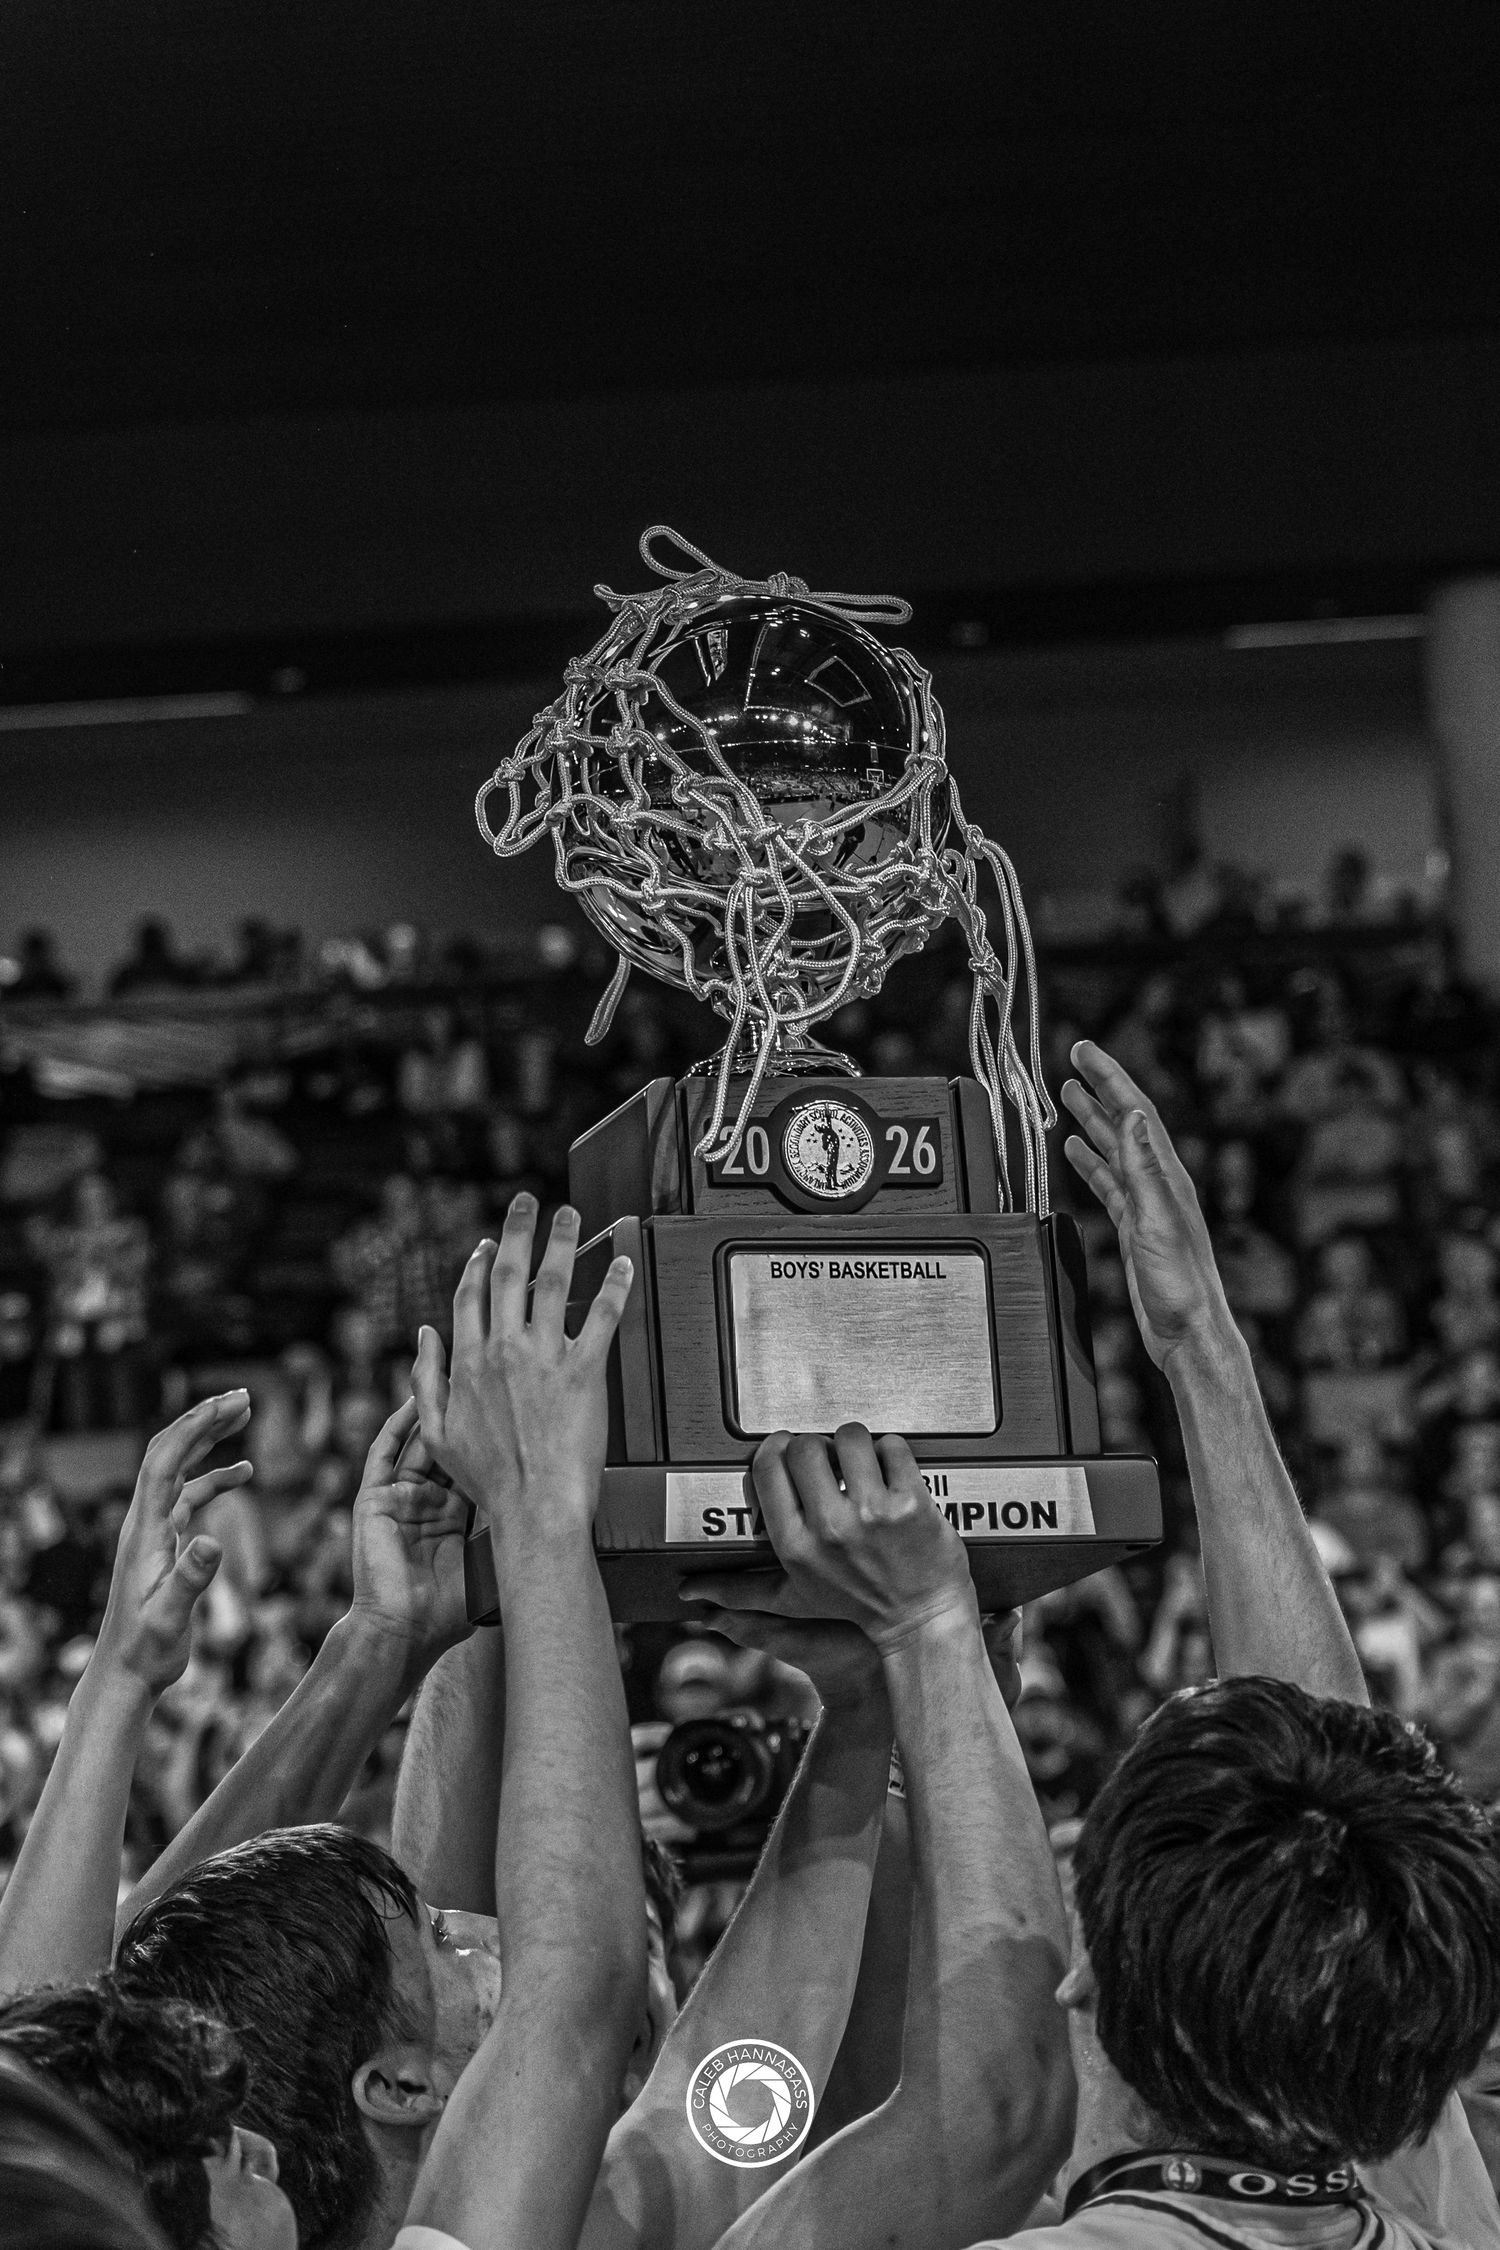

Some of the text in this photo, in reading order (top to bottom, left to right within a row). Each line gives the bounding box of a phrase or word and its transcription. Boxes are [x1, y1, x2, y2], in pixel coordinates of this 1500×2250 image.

[719, 1125, 770, 1175] 20
[789, 1116, 811, 1158] SECONDARY
[809, 1108, 839, 1121] SCHOL
[840, 1113, 869, 1147] ACTIVITIES
[885, 1125, 936, 1174] 26
[770, 1261, 947, 1279] BOYS' BASKETBALL
[1229, 2170, 1358, 2197] OSS
